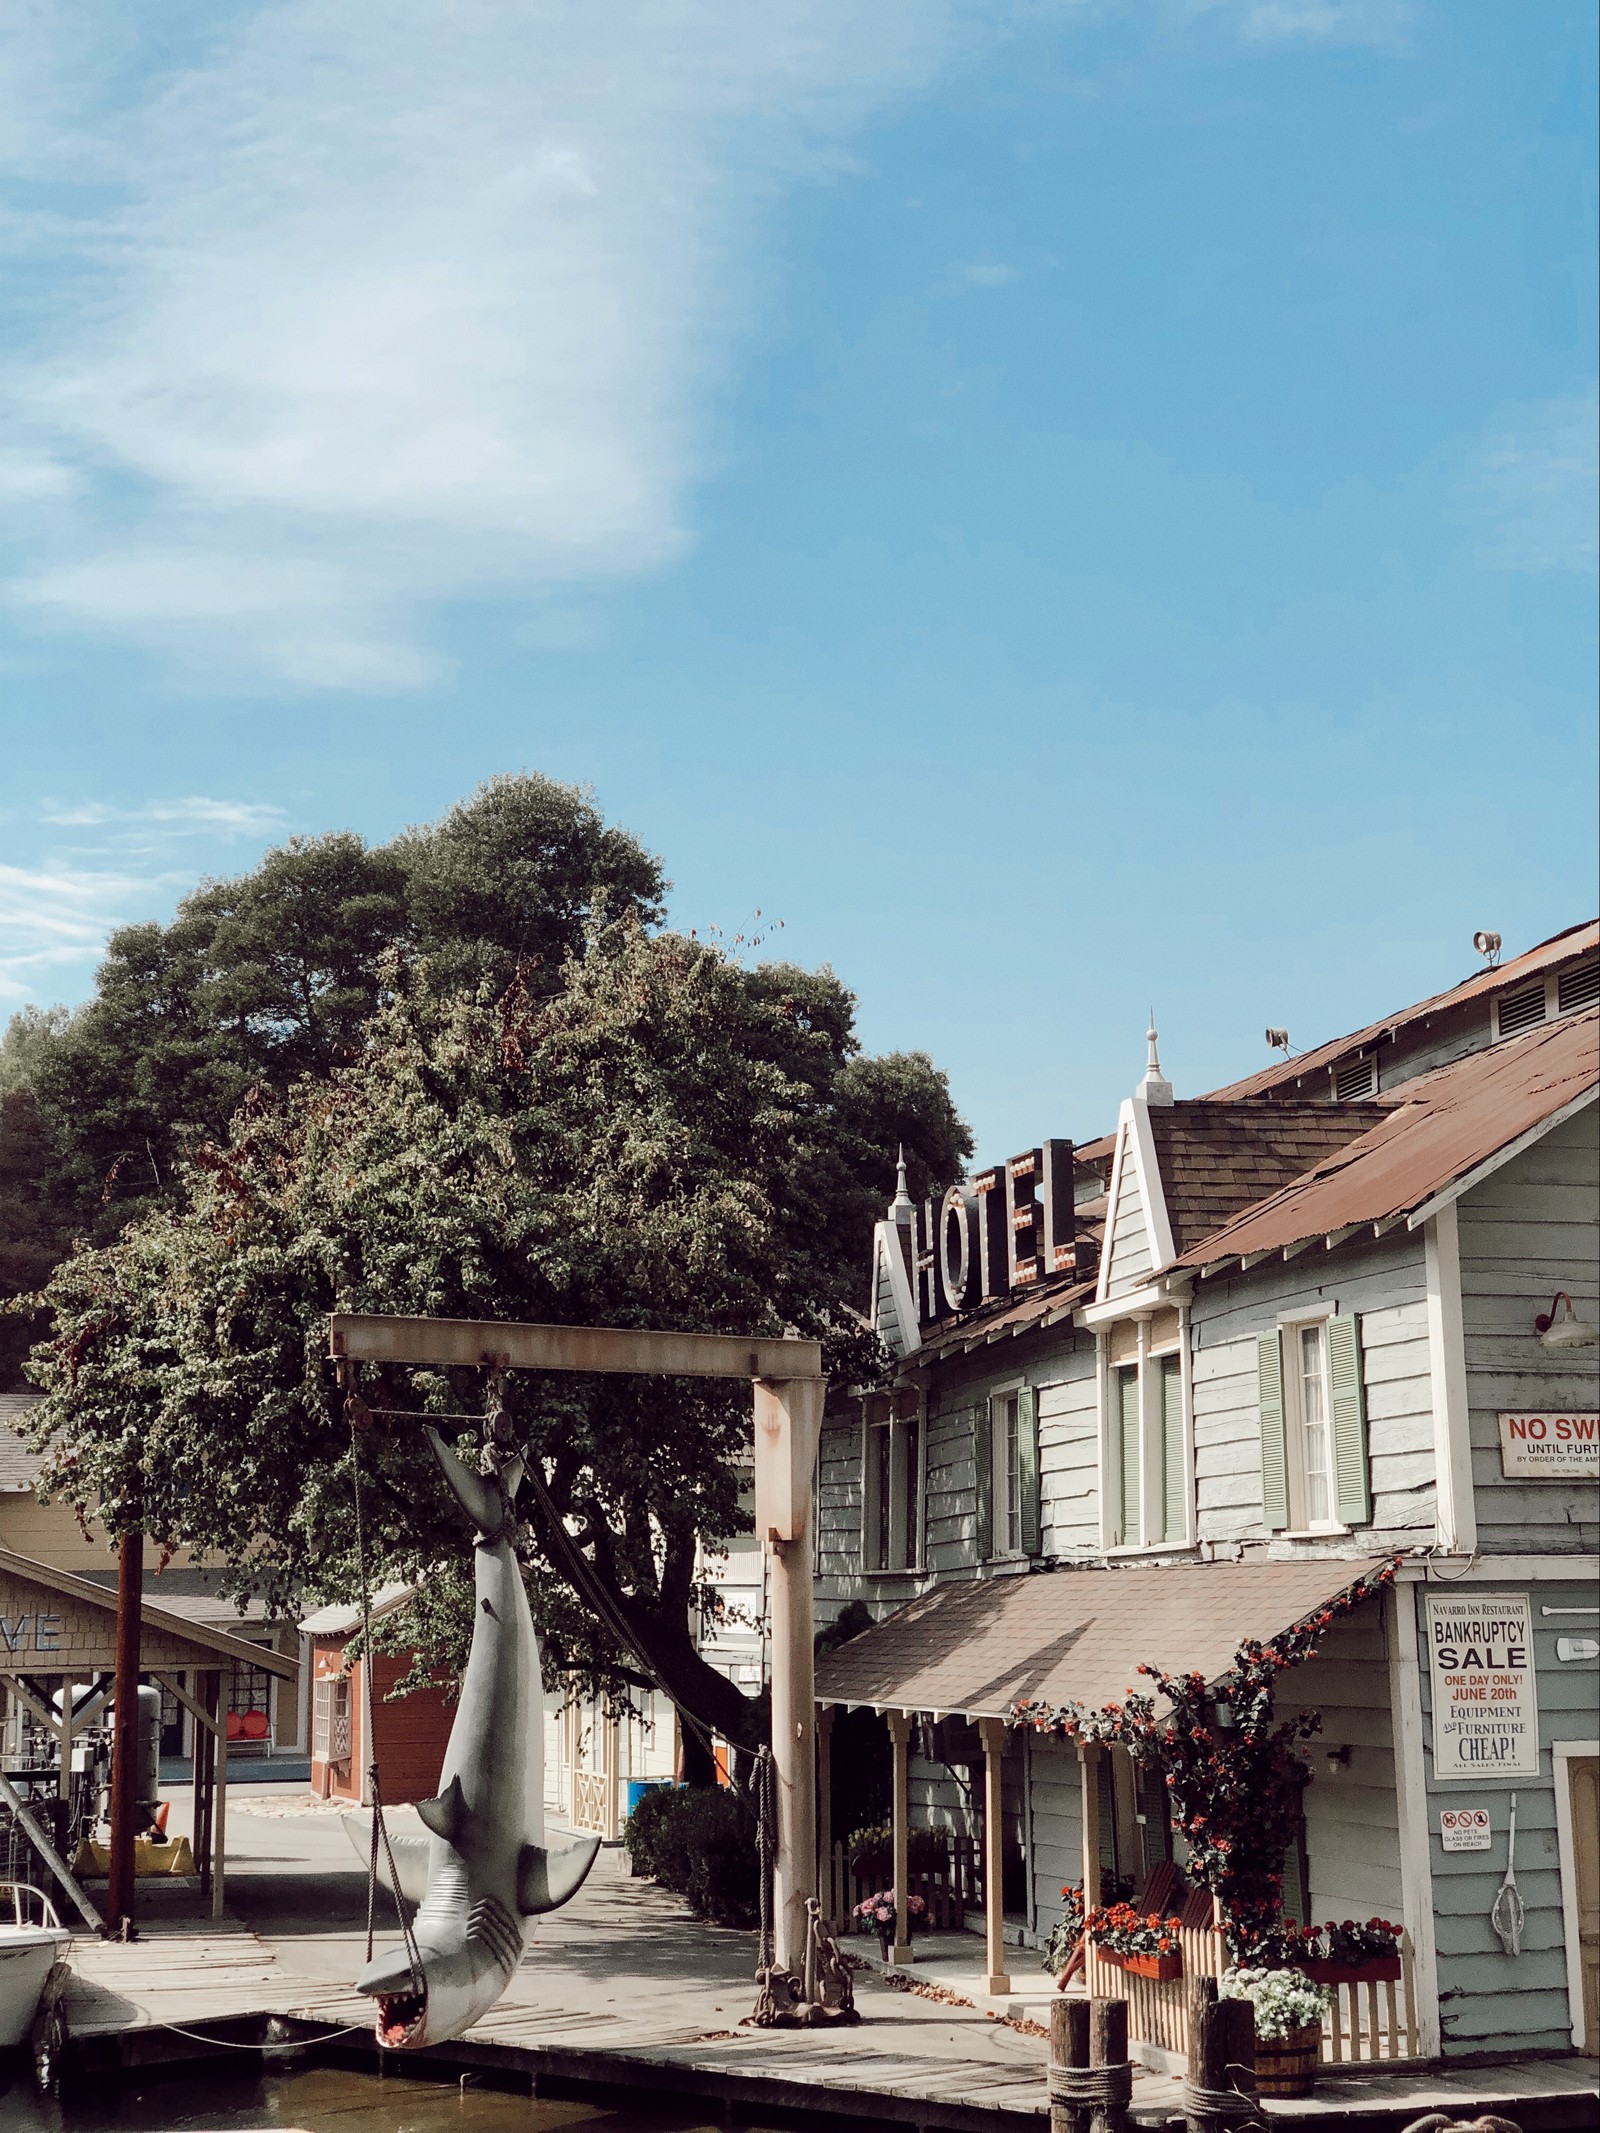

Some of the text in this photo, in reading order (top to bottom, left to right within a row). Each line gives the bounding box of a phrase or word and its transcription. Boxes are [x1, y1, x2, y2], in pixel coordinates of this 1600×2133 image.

[911, 1139, 1100, 1324] HOTEL
[1509, 1418, 1547, 1440] NO
[1527, 1444, 1599, 1454] UNTIL FURT
[1434, 1621, 1525, 1643] BANKRUPTCY
[1438, 1647, 1527, 1670] SALE
[1444, 1675, 1523, 1686] ONE DAY ONLY!
[1452, 1687, 1517, 1701] JUNE 20th
[1458, 1737, 1515, 1761] CHEAP!
